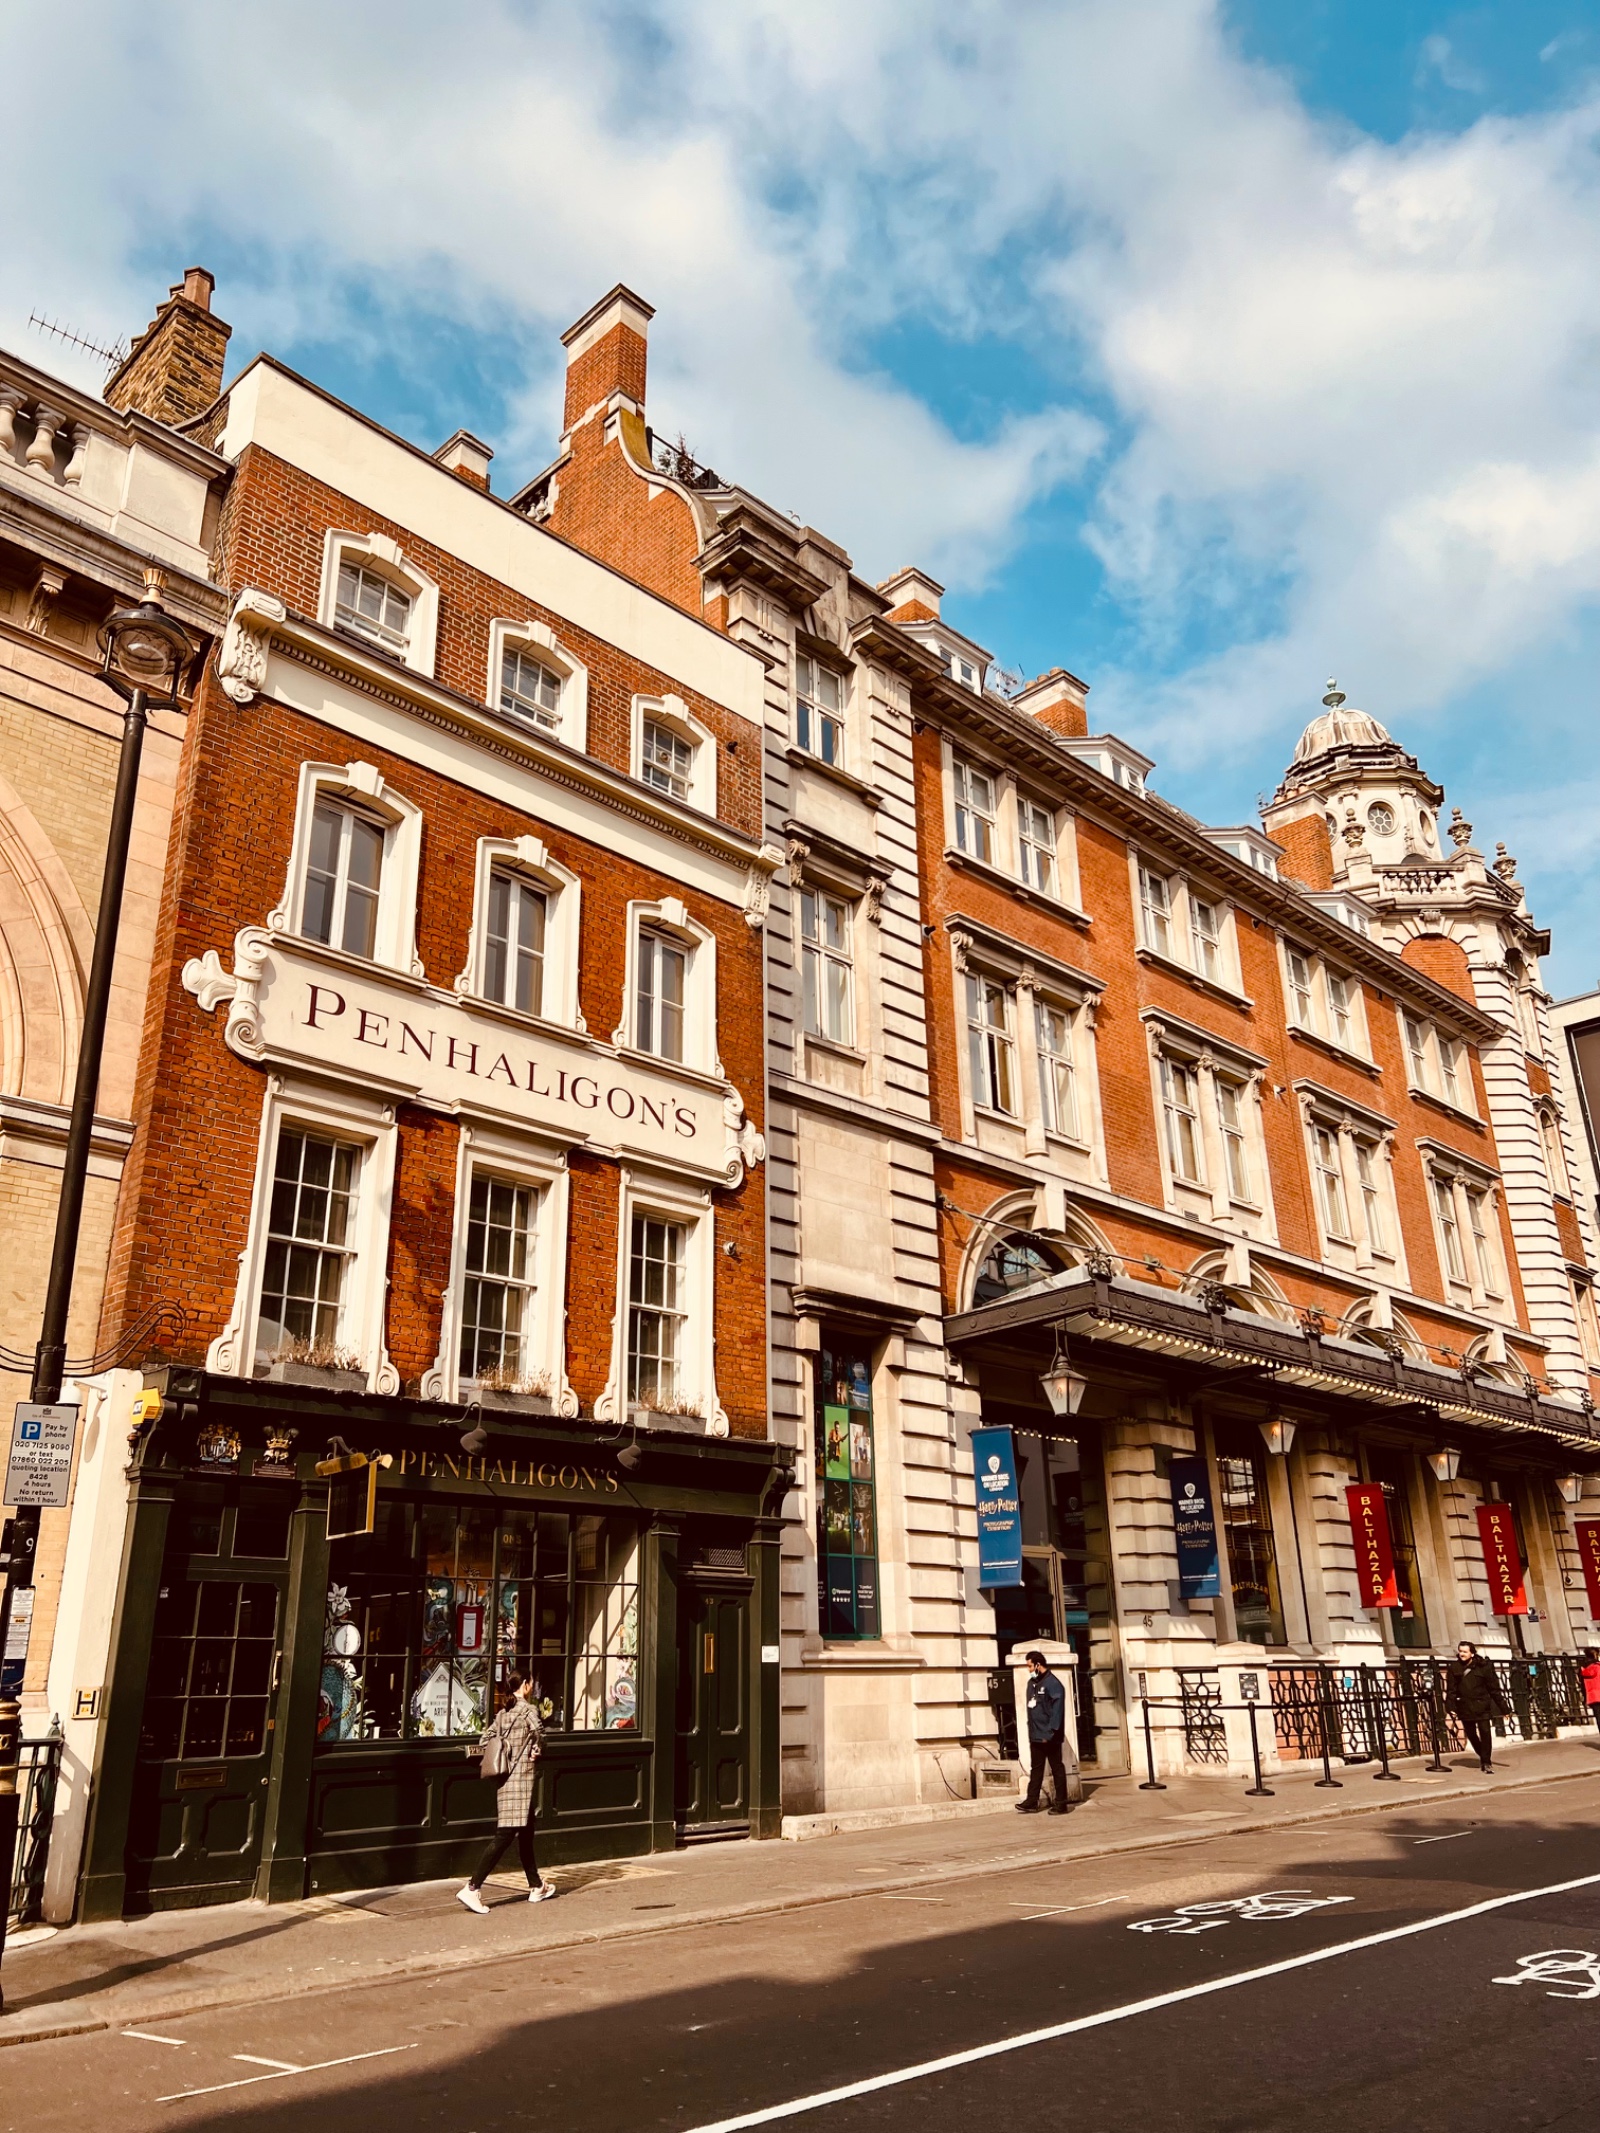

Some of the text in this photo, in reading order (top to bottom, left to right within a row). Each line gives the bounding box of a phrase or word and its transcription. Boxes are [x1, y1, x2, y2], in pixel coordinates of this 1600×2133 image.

[301, 982, 698, 1139] PENHALIGON'S
[25, 1423, 38, 1438] P
[45, 1423, 68, 1432] Pay by
[14, 1440, 30, 1448] 020
[399, 1449, 619, 1494] PENHALIGON'S
[978, 1498, 1018, 1517] Harry Potter
[1176, 1520, 1213, 1536] Harry Potter
[1361, 1496, 1384, 1595] BALTHAZAR
[1490, 1515, 1515, 1604] BALTHAZAR
[1142, 1614, 1153, 1628] 45
[988, 1678, 999, 1689] 45
